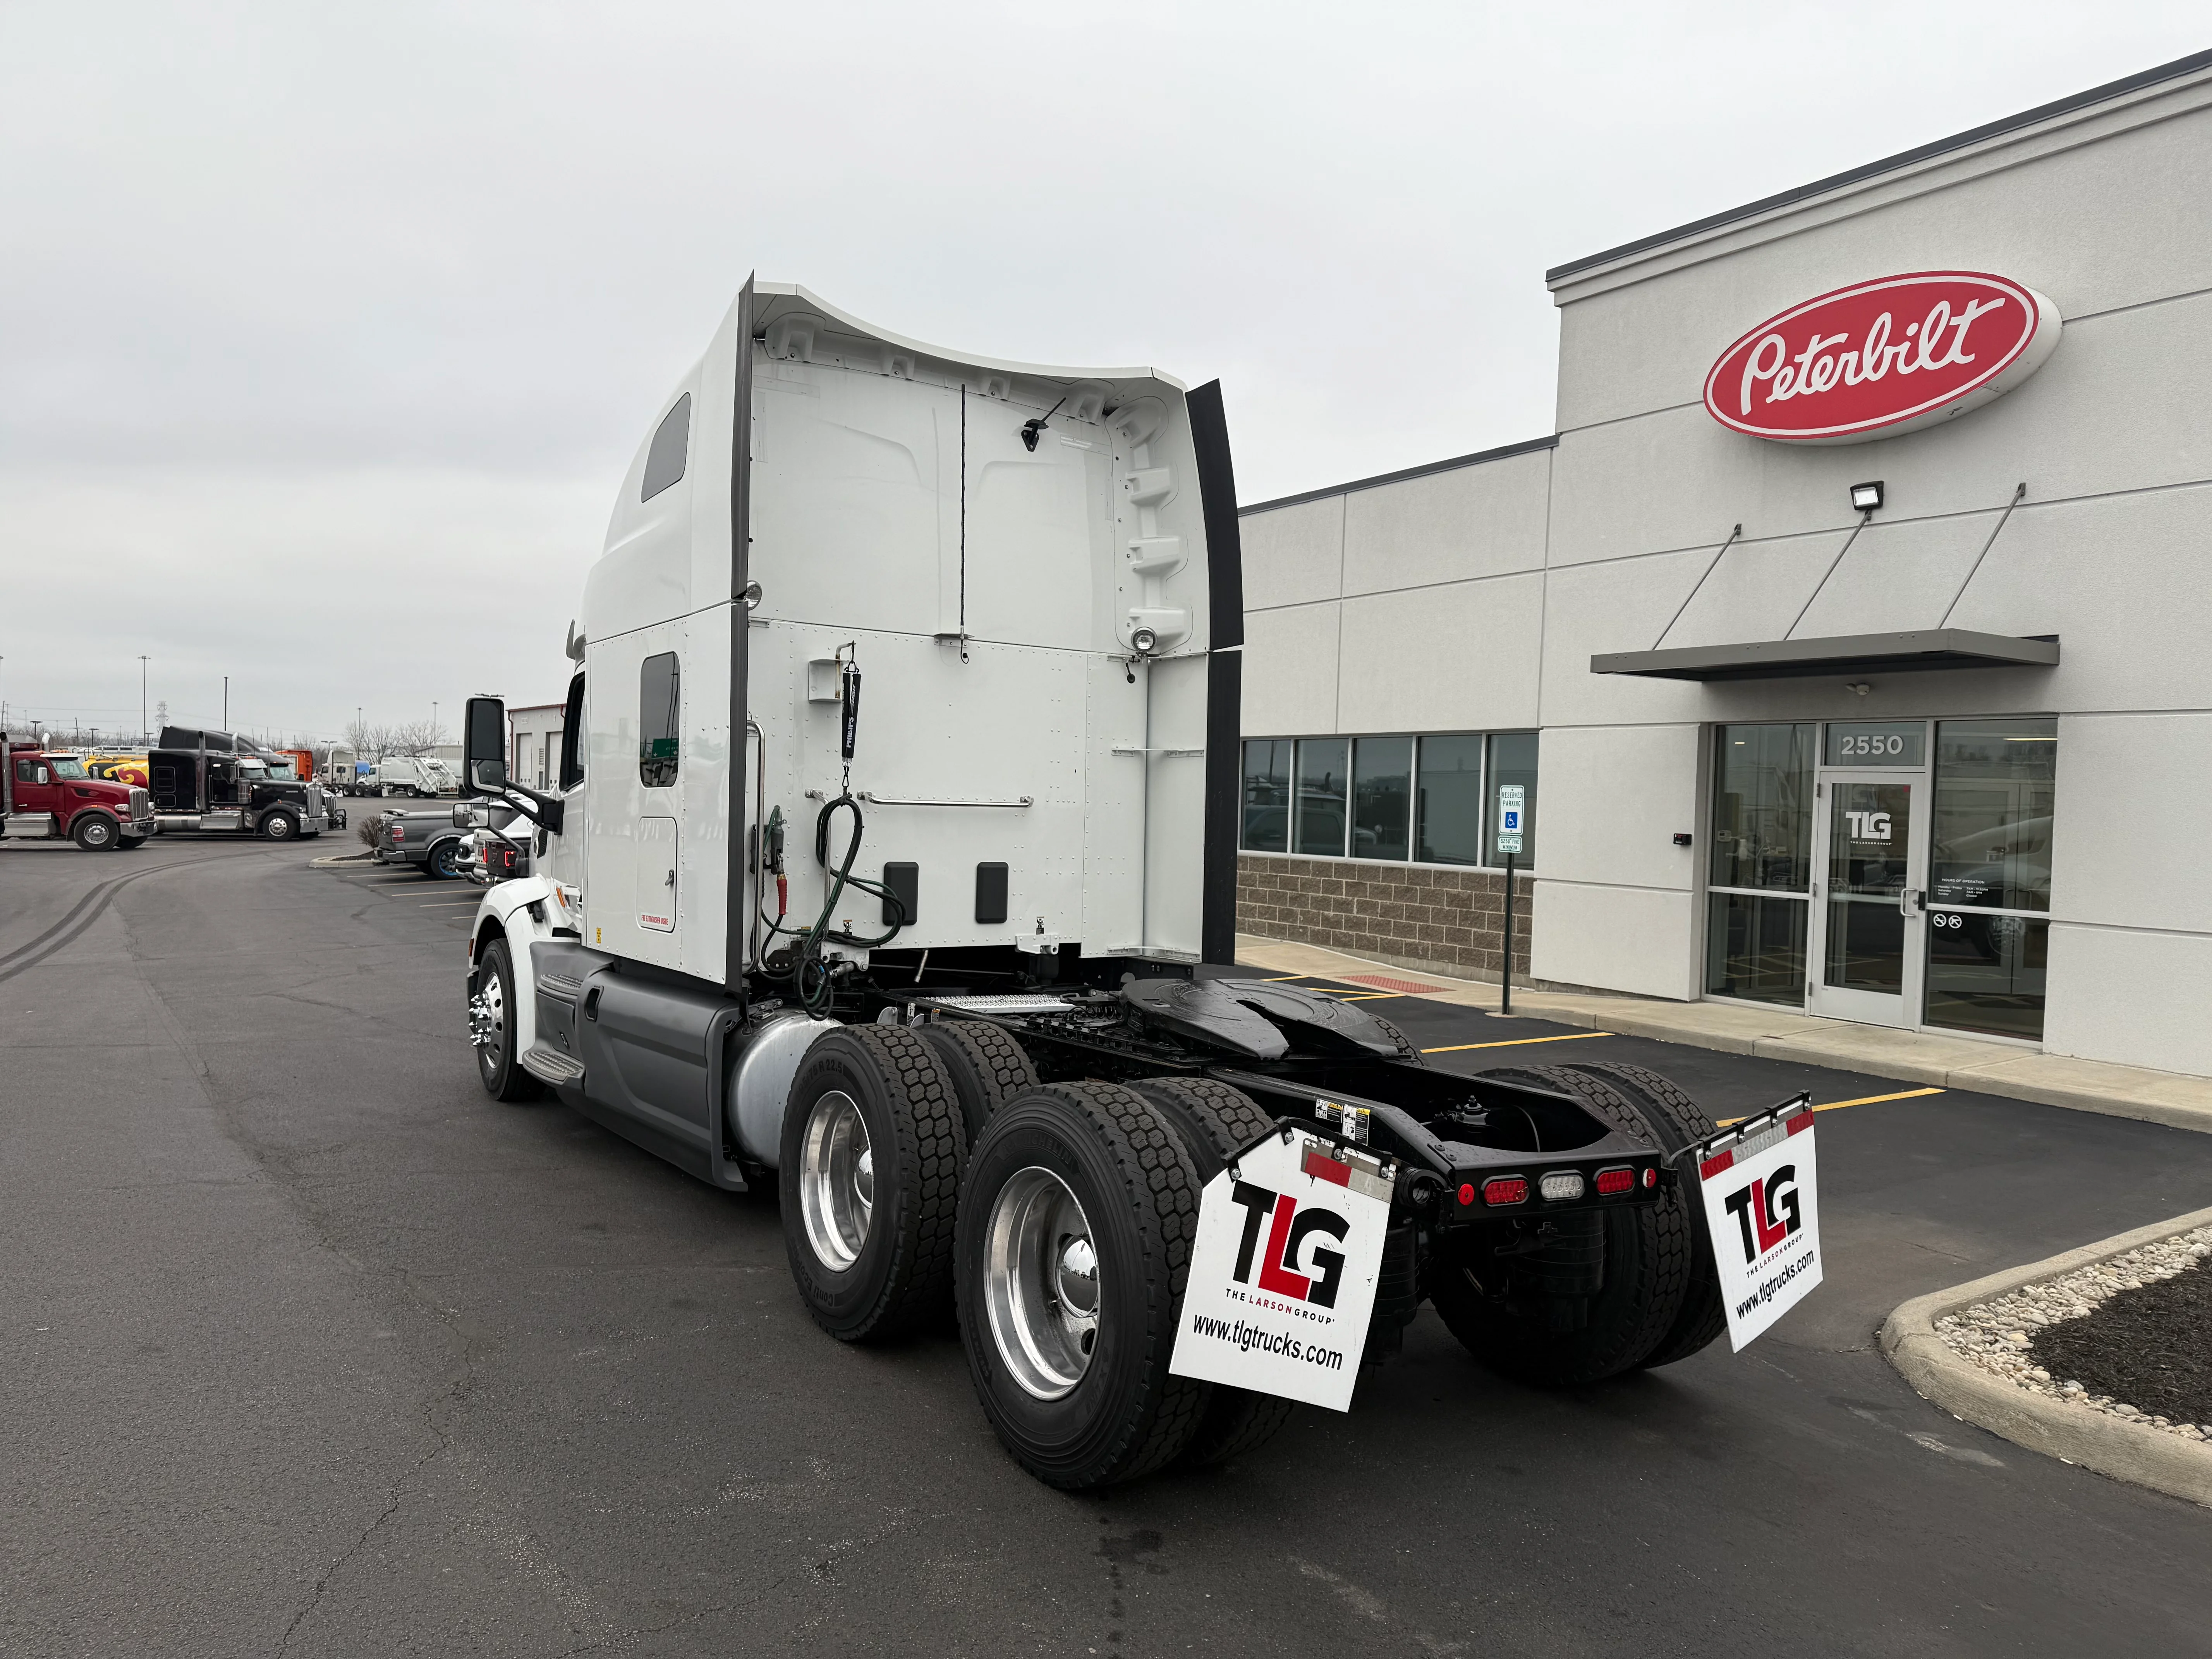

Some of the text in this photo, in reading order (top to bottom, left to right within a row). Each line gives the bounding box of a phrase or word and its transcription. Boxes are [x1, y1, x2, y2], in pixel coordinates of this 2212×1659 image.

[1740, 297, 2006, 416] Peterbilt
[1841, 735, 1903, 755] 2550
[1846, 812, 1891, 839] TLG
[826, 1058, 842, 1073] 22.5
[1724, 1164, 1802, 1265] TLG
[1231, 1179, 1350, 1310] TLG
[1746, 1235, 1802, 1278] THE LARSON GROUP
[1226, 1288, 1332, 1325] THE LARSON GROUP
[1736, 1249, 1814, 1320] www.tlgtrucks.com
[1193, 1314, 1343, 1370] www.tlgtrucks.com
